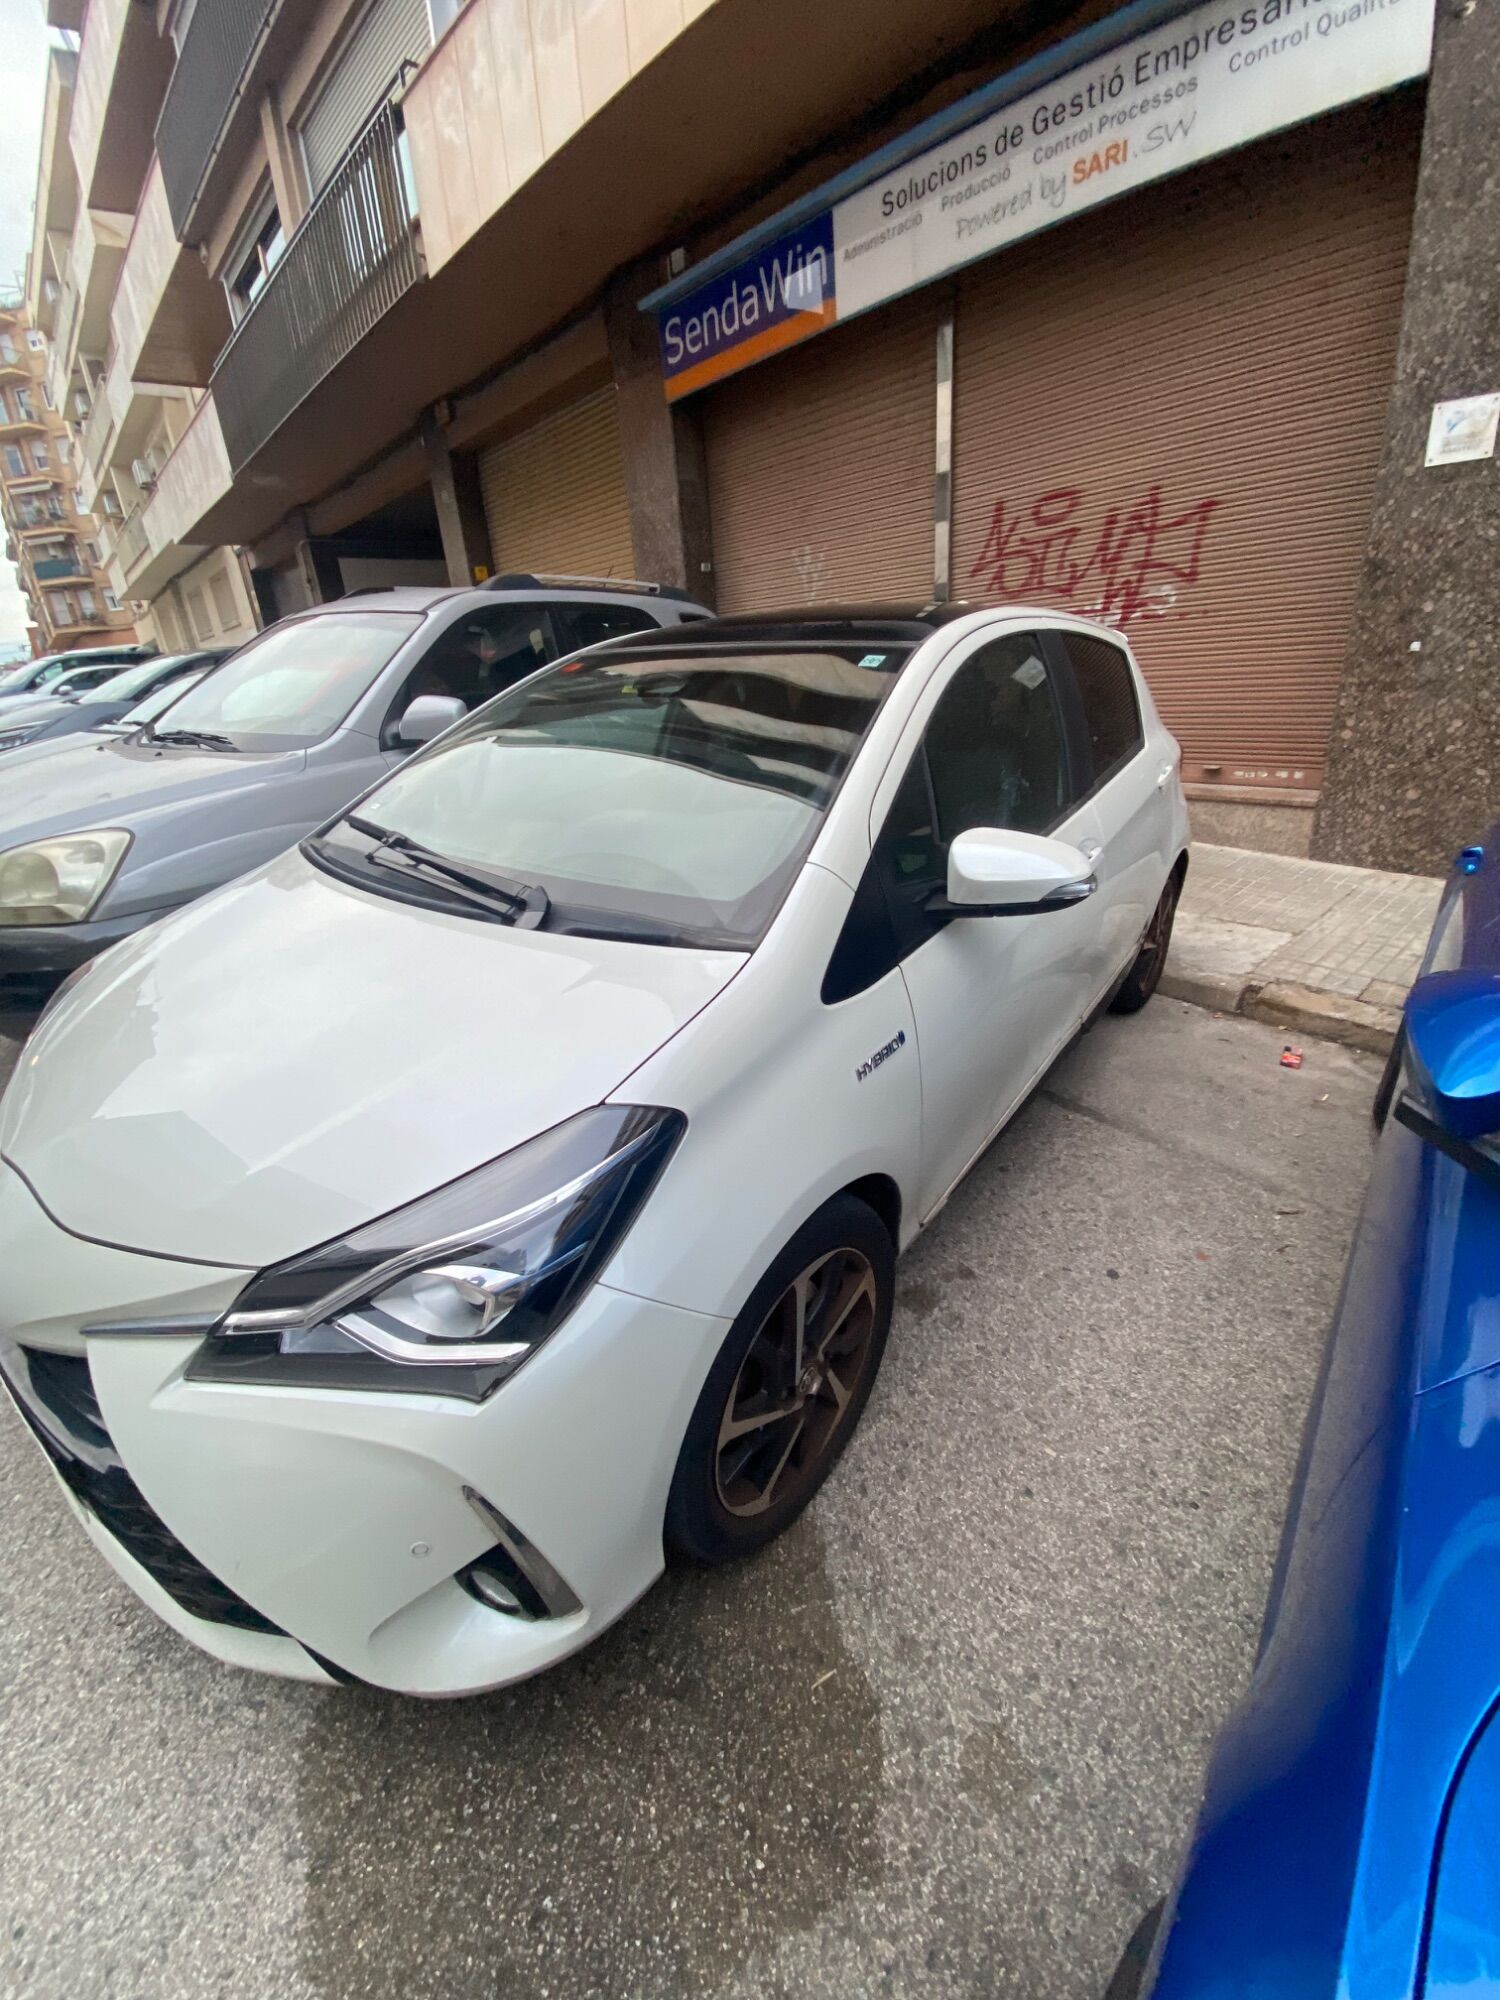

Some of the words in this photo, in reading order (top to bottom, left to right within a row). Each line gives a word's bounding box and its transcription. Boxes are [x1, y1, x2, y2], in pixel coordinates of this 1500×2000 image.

[1228, 22, 1309, 74] Control
[881, 144, 987, 217] Solucions
[994, 126, 1025, 156] de
[1032, 62, 1125, 136] Gestió
[1033, 120, 1094, 166] Control
[1098, 75, 1199, 135] Processos
[940, 162, 1011, 212] Producció
[956, 182, 1032, 240] Powered
[1040, 171, 1068, 208] by
[1072, 138, 1129, 185] SARI
[843, 210, 923, 263] Administració
[664, 243, 828, 365] SendaWin
[855, 1037, 900, 1083] HYBRID
